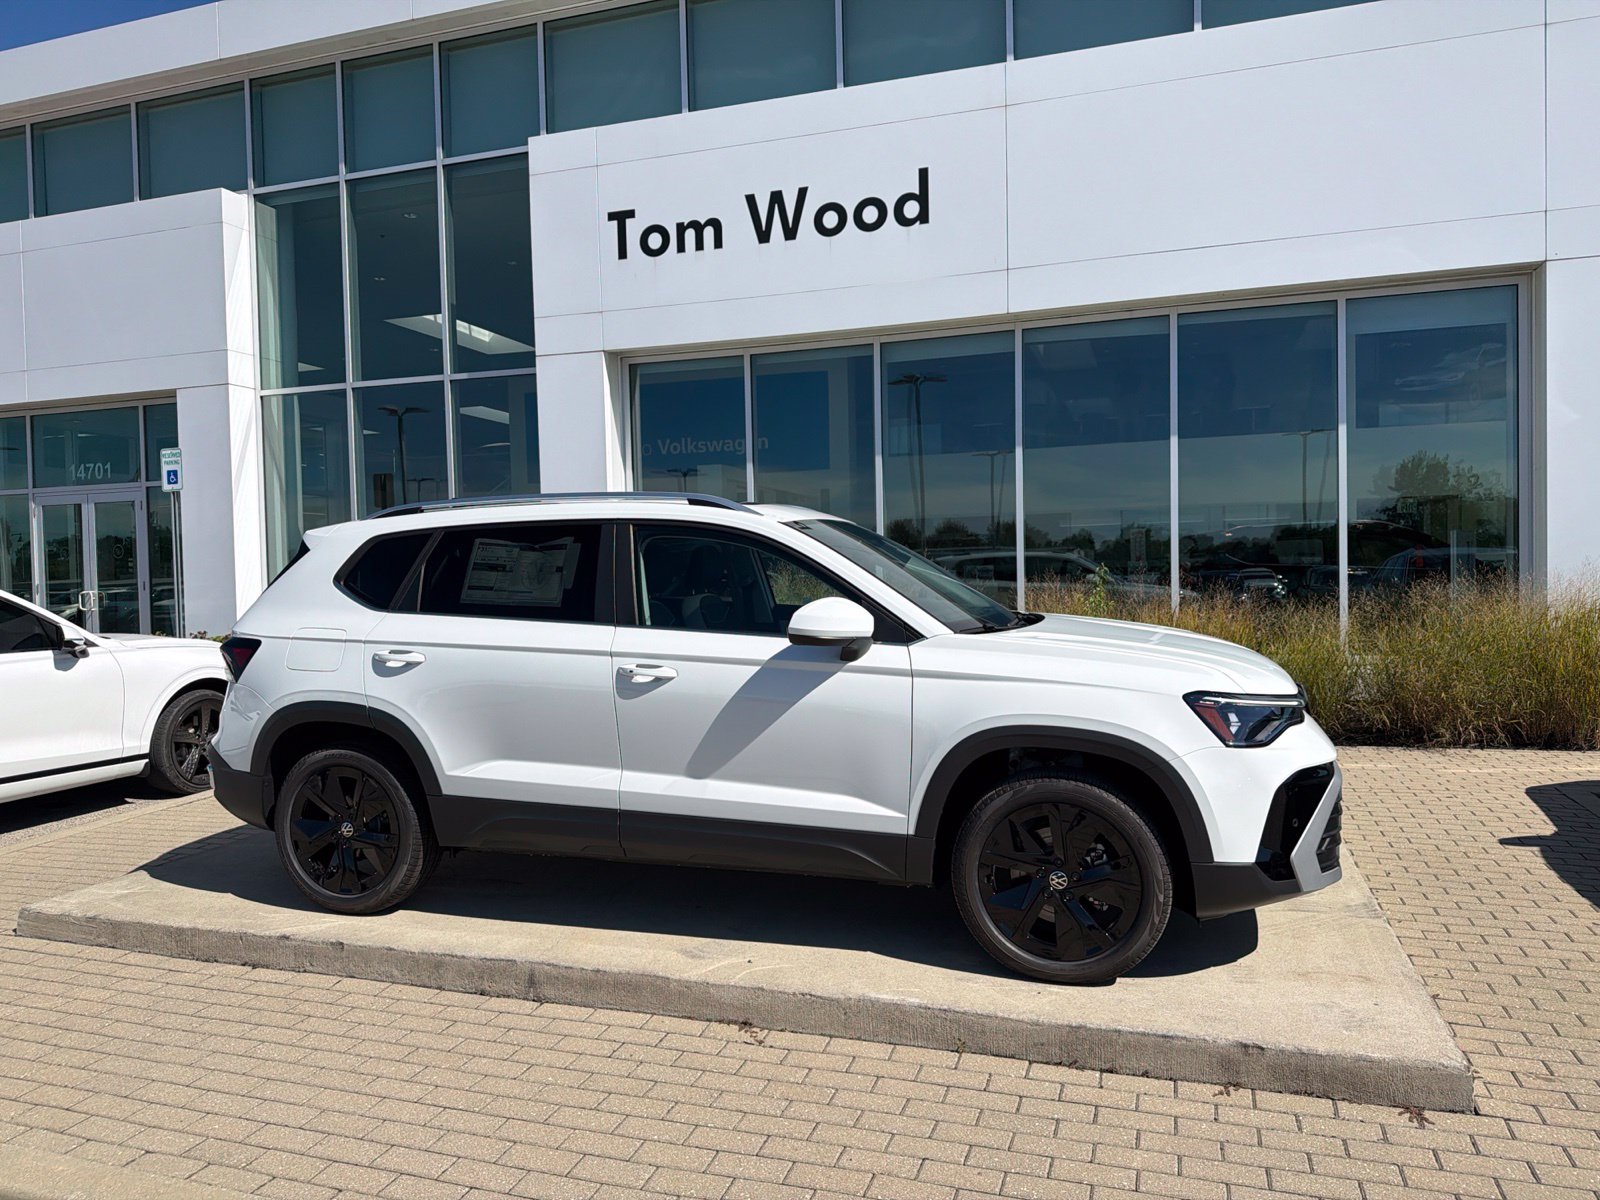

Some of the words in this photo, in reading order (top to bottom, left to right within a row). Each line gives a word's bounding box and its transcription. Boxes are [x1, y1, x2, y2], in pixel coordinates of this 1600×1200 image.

[607, 208, 723, 260] Tom
[744, 166, 930, 245] Wood
[658, 436, 769, 455] Volkswagn
[70, 462, 111, 480] 14701
